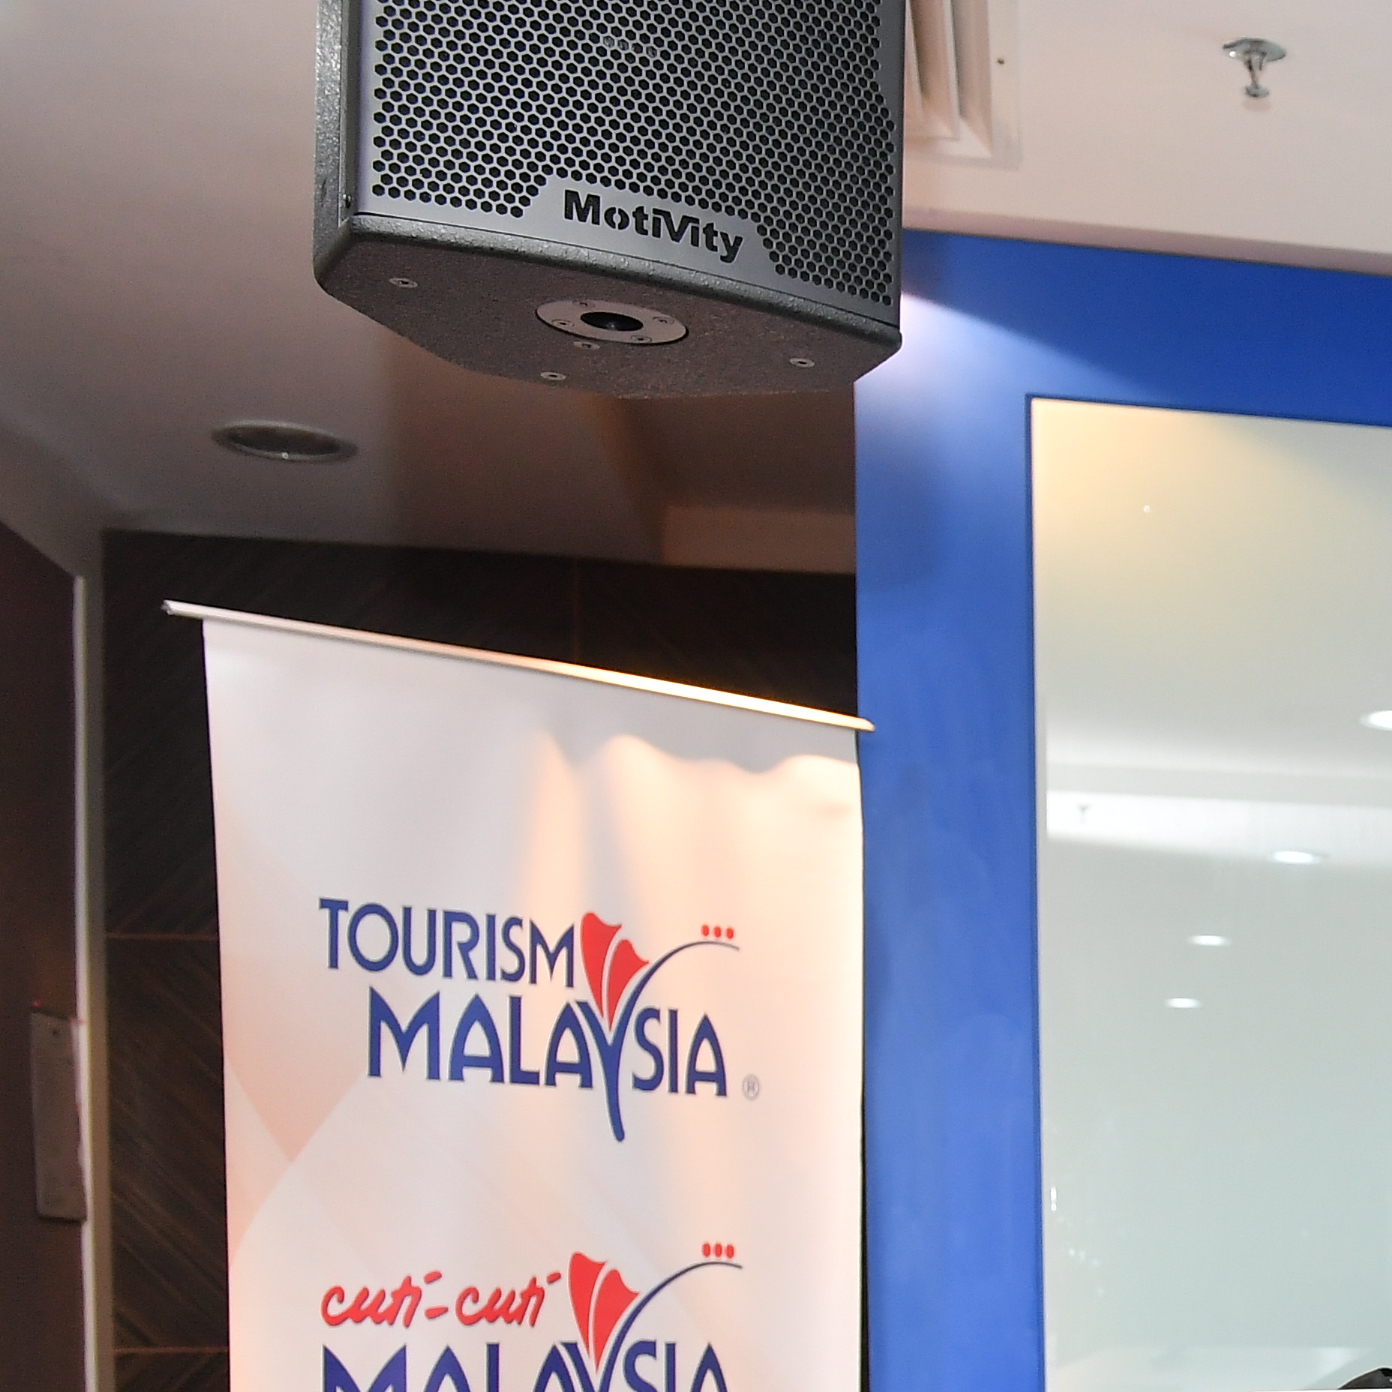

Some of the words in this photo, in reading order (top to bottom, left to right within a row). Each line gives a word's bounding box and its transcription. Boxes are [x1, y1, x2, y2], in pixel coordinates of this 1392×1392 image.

[319, 897, 575, 988] TOURISM
[367, 986, 728, 1141] MALAYSIA
[320, 1270, 562, 1328] cuti-cuti
